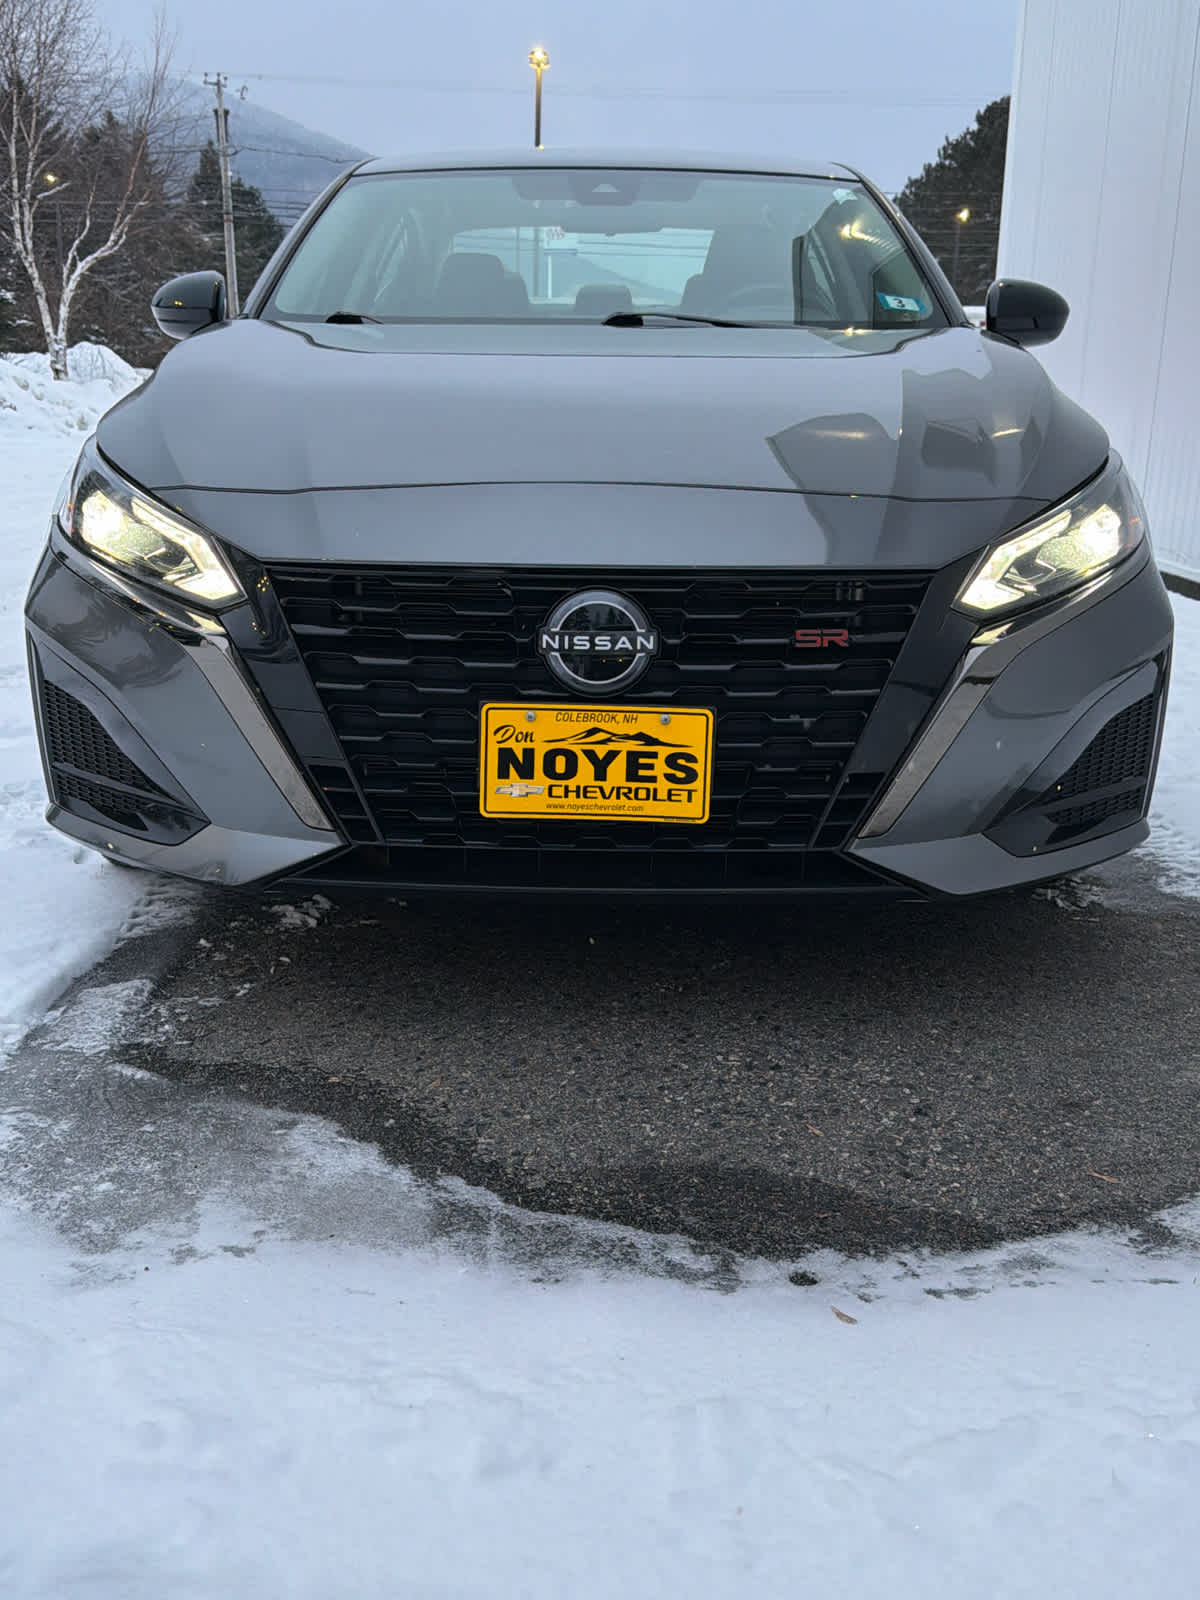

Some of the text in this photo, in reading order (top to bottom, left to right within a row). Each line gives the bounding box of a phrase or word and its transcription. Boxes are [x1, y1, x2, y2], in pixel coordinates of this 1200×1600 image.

[893, 298, 905, 308] 3
[541, 633, 655, 651] NISSAN
[794, 628, 849, 648] SR
[555, 711, 639, 724] COLEBROOK, NH
[493, 724, 535, 744] Don
[497, 747, 699, 785] NOYES
[548, 784, 698, 803] CHEVROLET
[546, 803, 644, 813] www.noyeschevrolet.com
